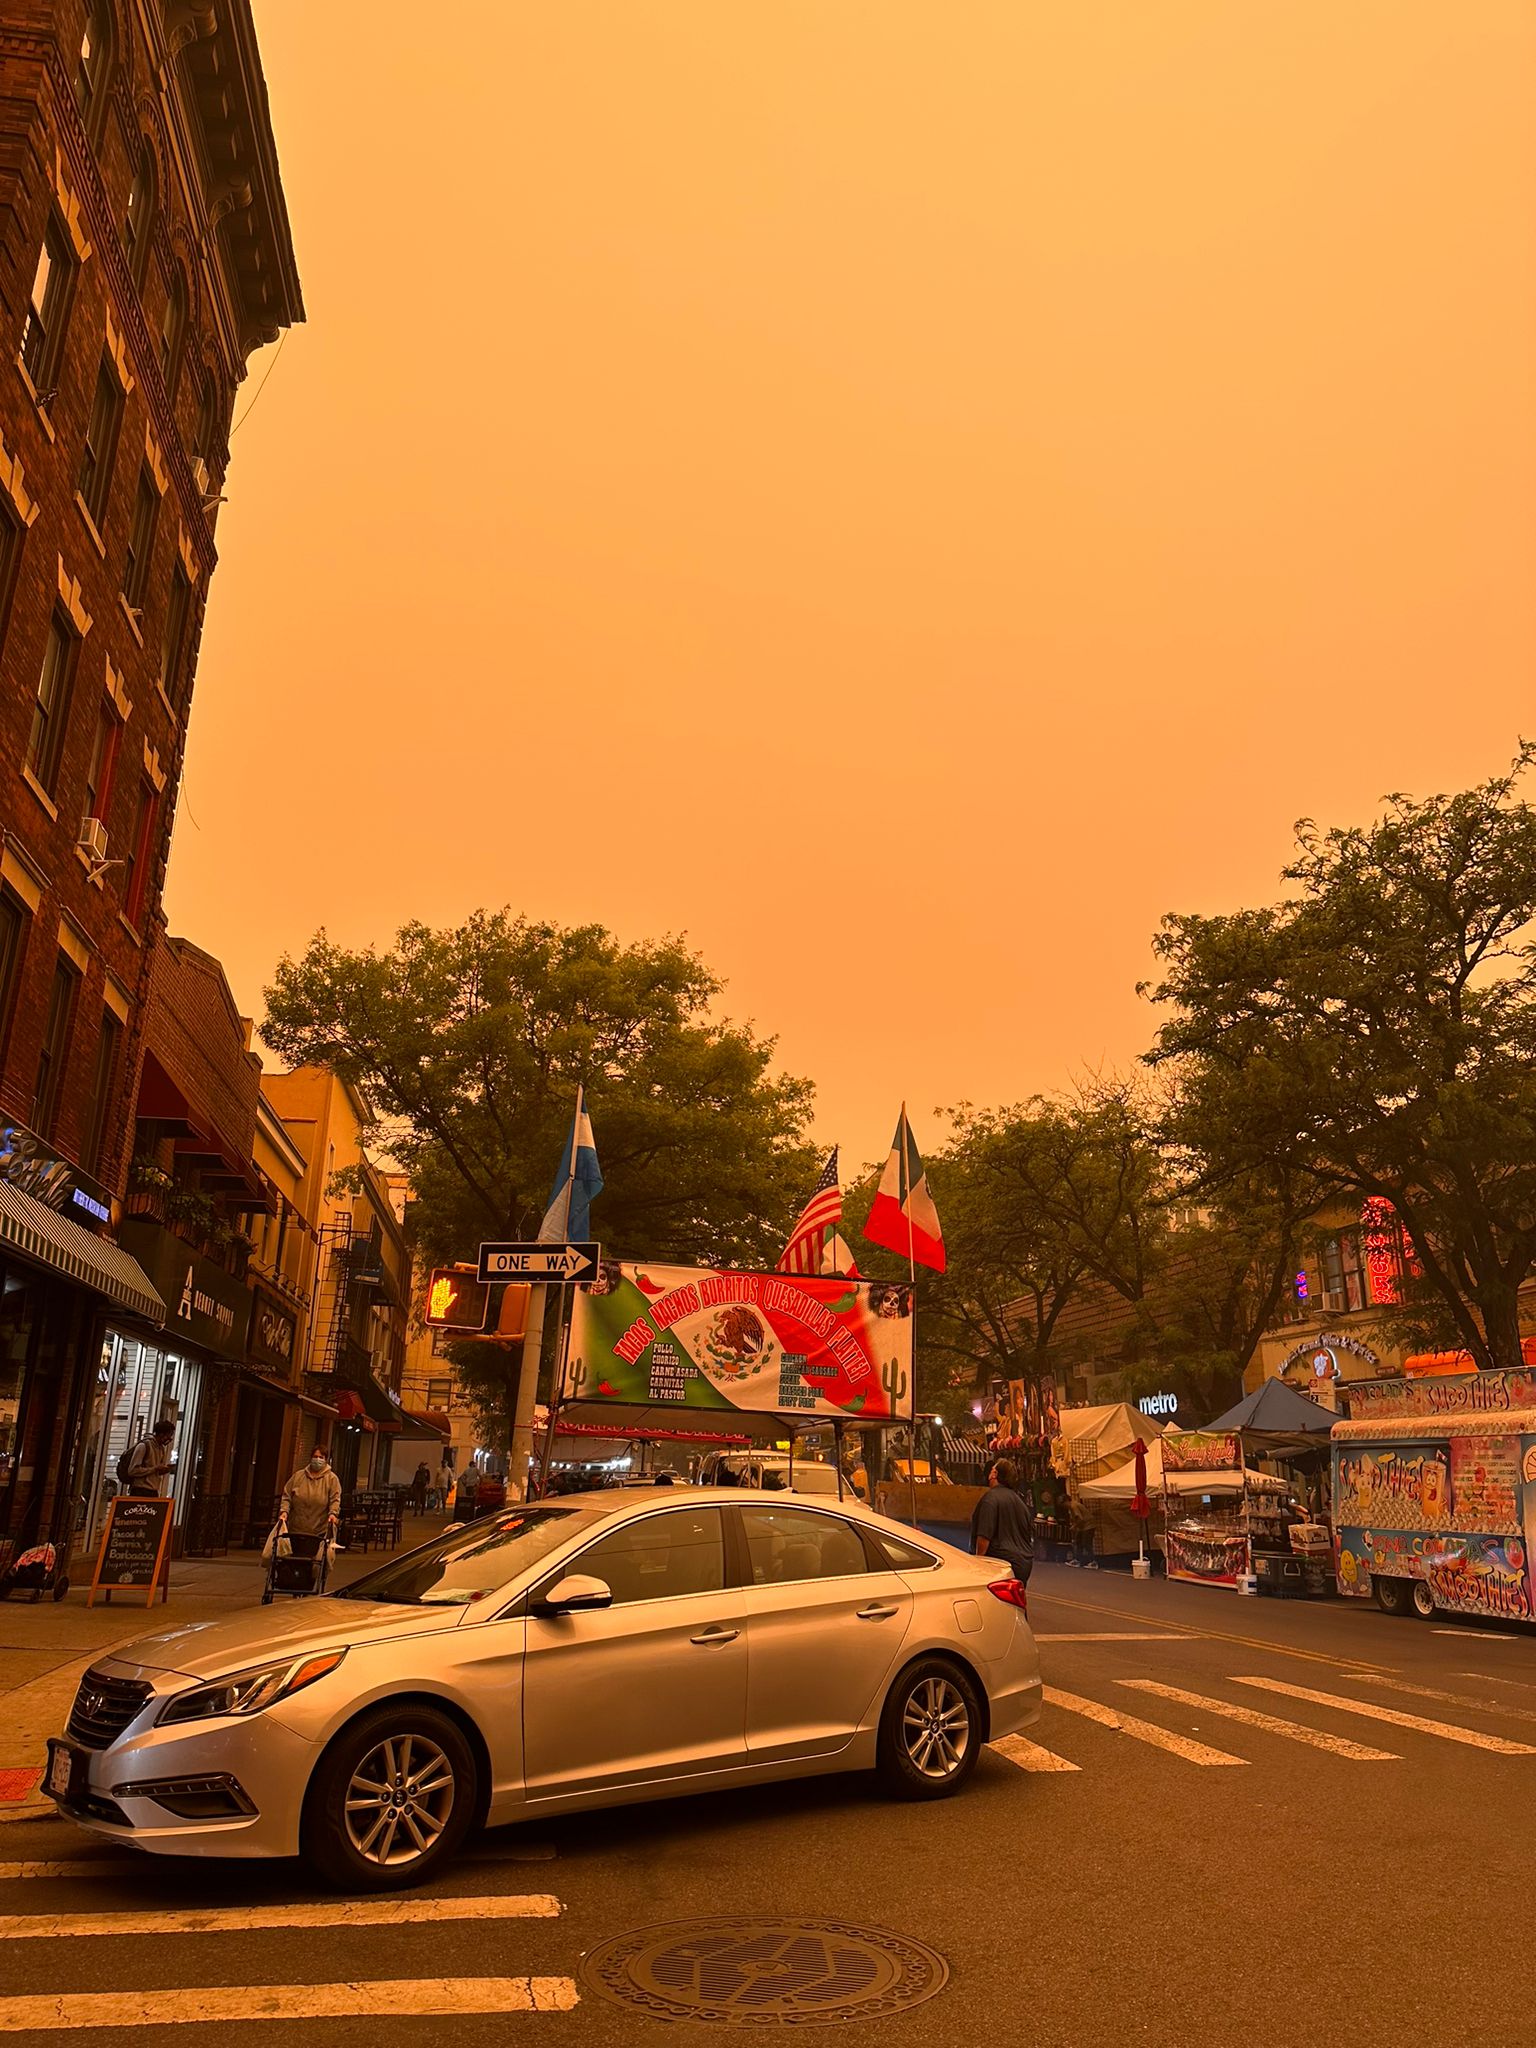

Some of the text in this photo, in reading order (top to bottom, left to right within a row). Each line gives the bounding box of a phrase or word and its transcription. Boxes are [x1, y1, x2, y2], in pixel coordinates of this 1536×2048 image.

[497, 1255, 581, 1270] ONE WAY
[194, 1290, 215, 1317] BEAUTY
[216, 1303, 234, 1328] SUPPLY
[613, 1276, 872, 1383] TACOS NACHOS BURRITOS QUESADILLAS PLATTER
[653, 1343, 674, 1354] POLLO
[652, 1354, 680, 1366] CHORIZO
[781, 1353, 807, 1363] CHICKEN
[651, 1366, 698, 1378] CARNE ASADA
[811, 1365, 838, 1377] SAUSAGE
[650, 1377, 685, 1389] CARNITAS
[649, 1388, 686, 1400] AL PASTOR
[779, 1385, 825, 1398] ROASTED PORK
[1428, 1372, 1509, 1414] SMOOTHIES
[778, 1396, 816, 1408] SPICY PORK
[1139, 1391, 1178, 1415] metro
[1180, 1440, 1206, 1466] Candy
[124, 1506, 157, 1516] CORAZÓN
[114, 1517, 148, 1526] Tenemos
[111, 1528, 146, 1539] Tacos de
[110, 1538, 153, 1551] Birria y
[109, 1549, 155, 1560] Barbacoa
[1430, 1566, 1528, 1617] SMOOTHIES
